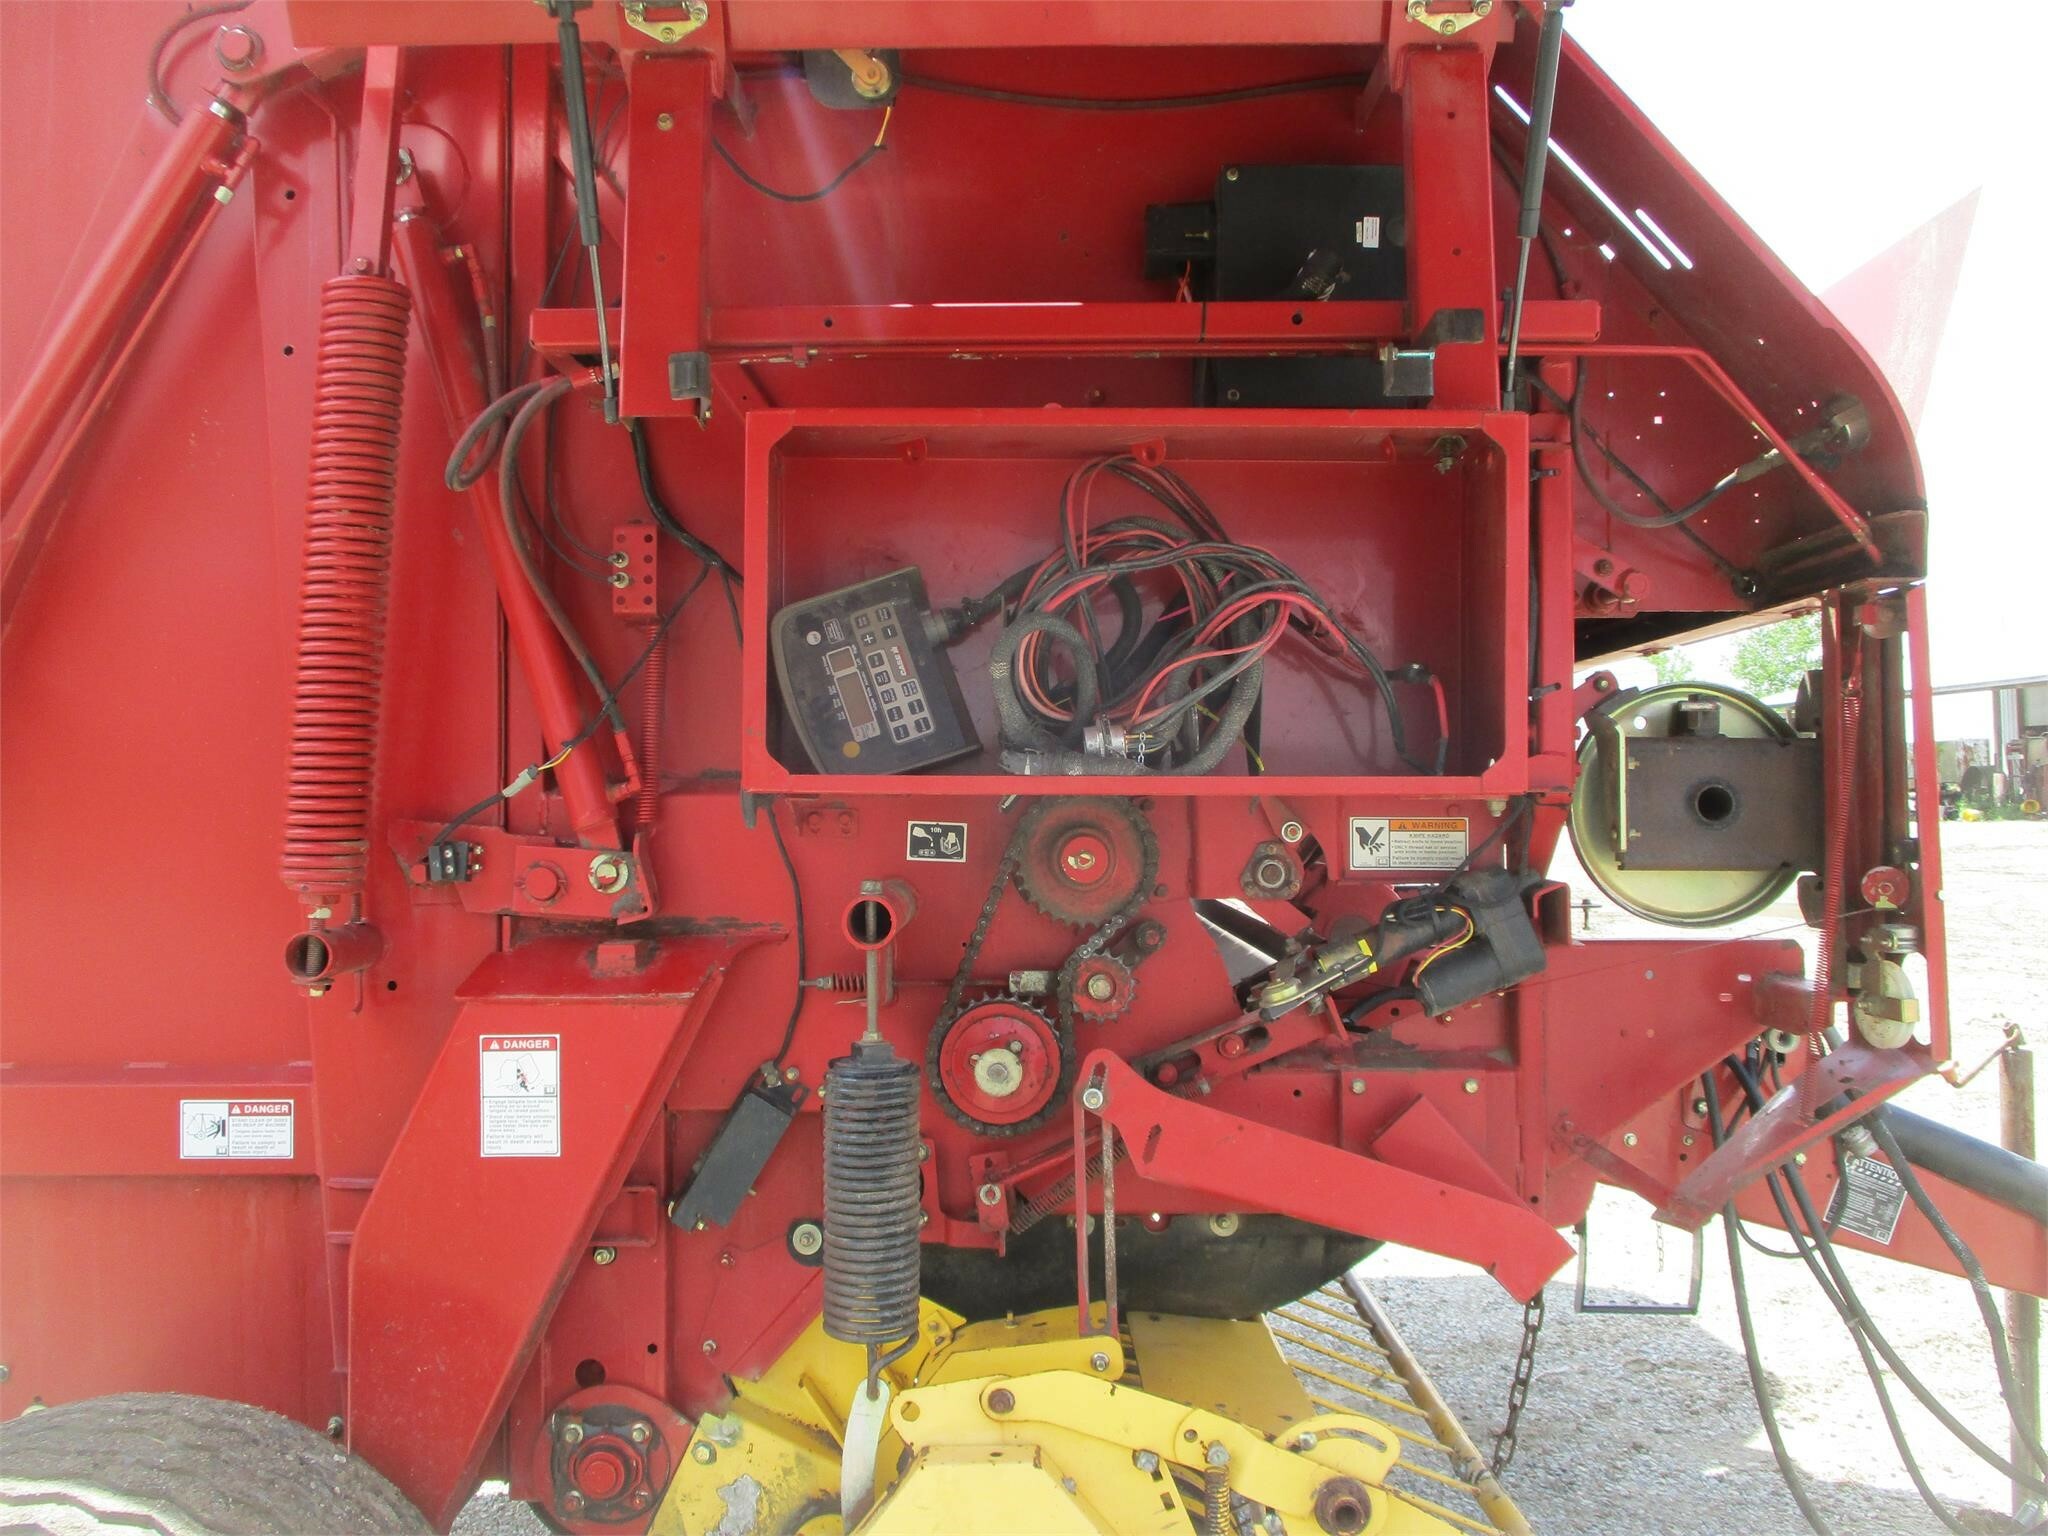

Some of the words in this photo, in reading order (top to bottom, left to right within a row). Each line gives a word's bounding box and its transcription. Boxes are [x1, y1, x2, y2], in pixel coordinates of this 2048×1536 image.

[894, 653, 906, 676] CASE
[503, 1040, 550, 1049] DANGER
[244, 1105, 289, 1113] DANGER
[1853, 1158, 1899, 1180] ATTENTIO
